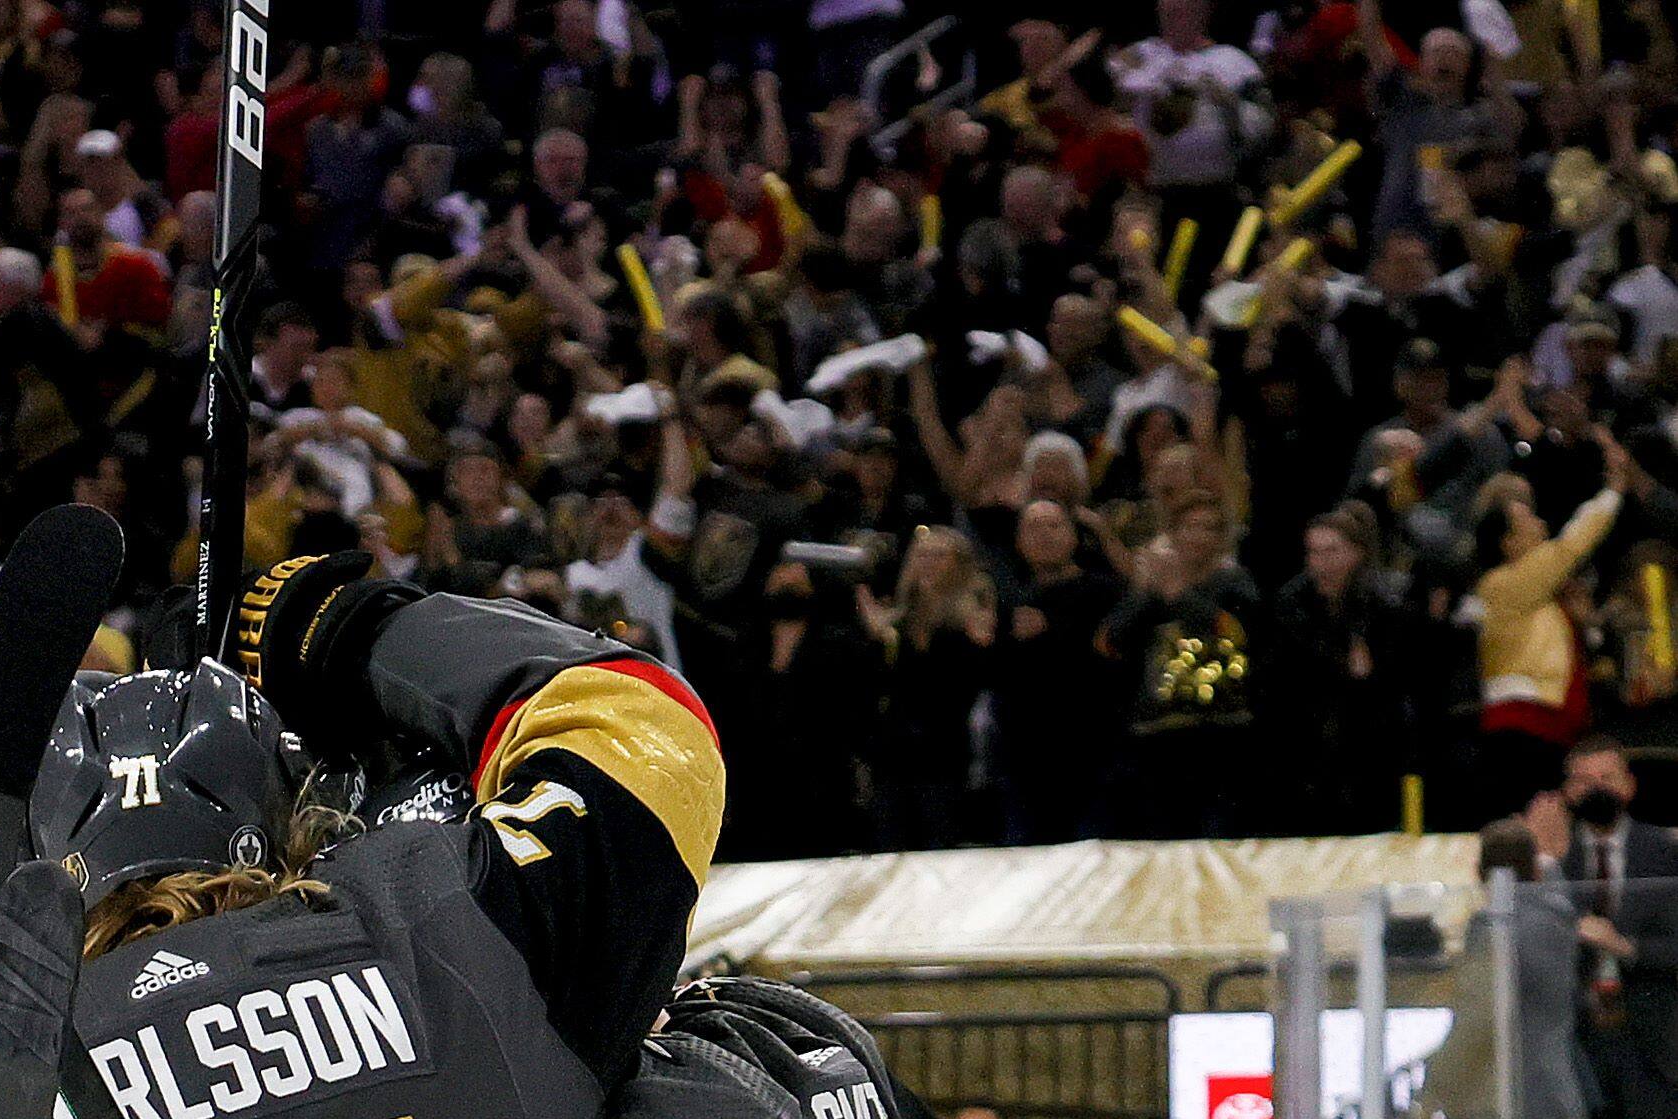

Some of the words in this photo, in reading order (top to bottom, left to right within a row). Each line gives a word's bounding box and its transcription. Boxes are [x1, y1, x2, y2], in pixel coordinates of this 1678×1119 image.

[196, 540, 210, 626] MARTINEZ
[109, 754, 162, 809] 71
[130, 961, 210, 999] adidas
